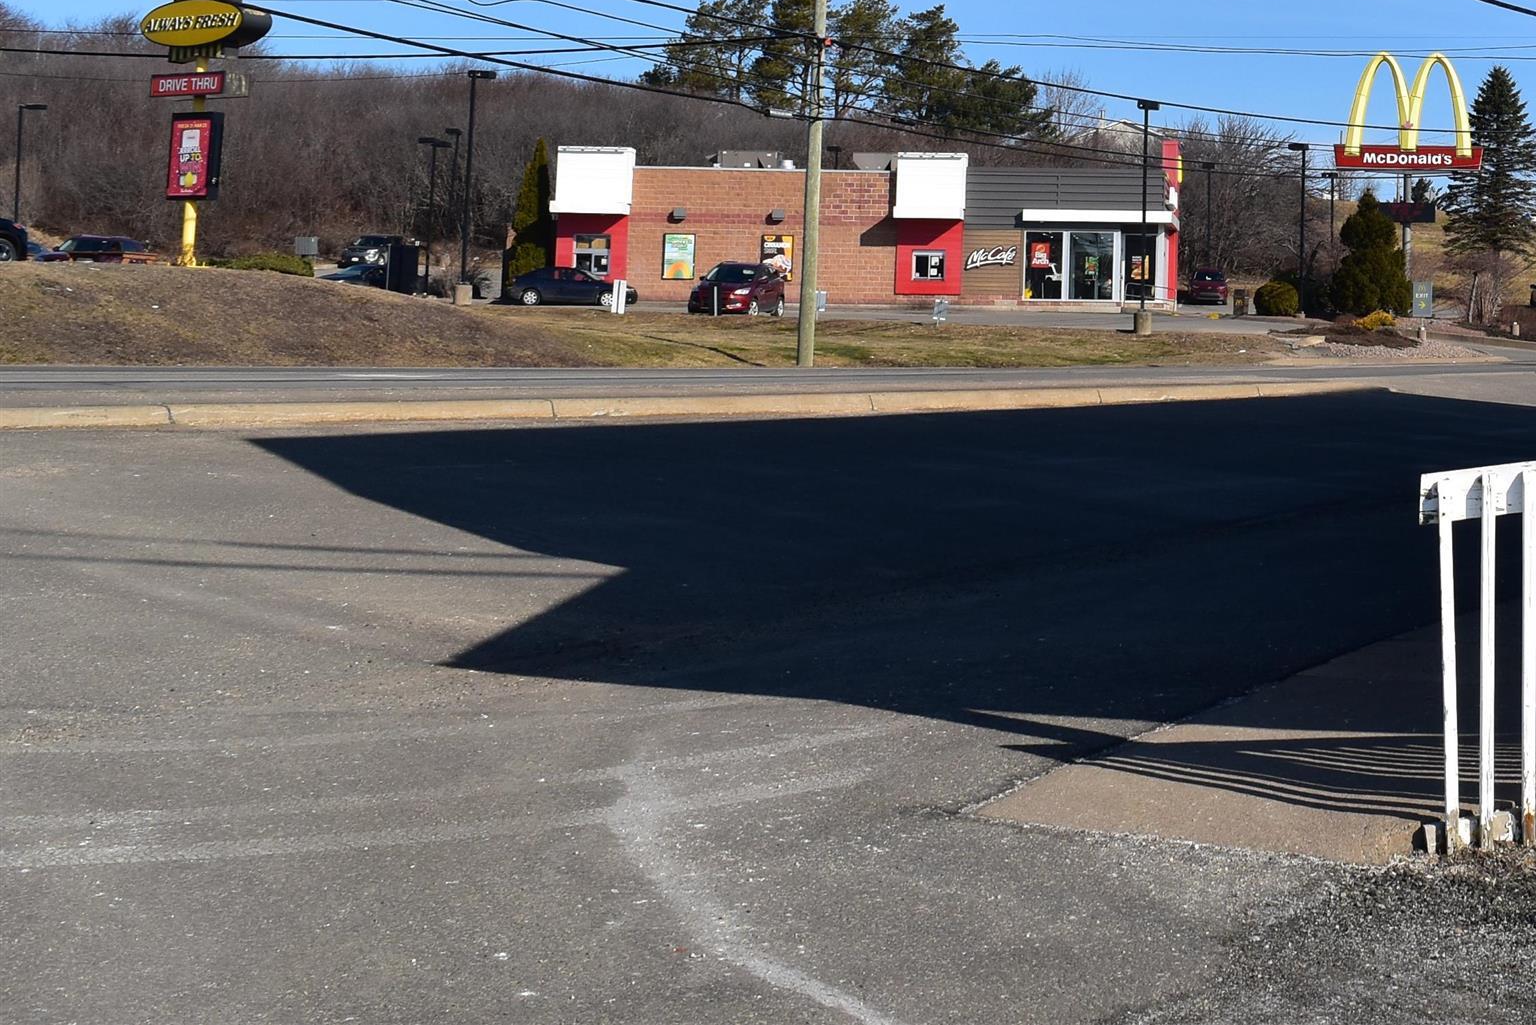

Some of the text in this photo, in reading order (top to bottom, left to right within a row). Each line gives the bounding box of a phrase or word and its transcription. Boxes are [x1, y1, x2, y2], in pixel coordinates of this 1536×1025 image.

[145, 12, 240, 32] ALWAYS FRESH
[159, 77, 217, 92] DRIVE THRU
[1363, 153, 1452, 164] McDonald's
[1032, 257, 1049, 265] Arch
[1034, 251, 1047, 261] Big
